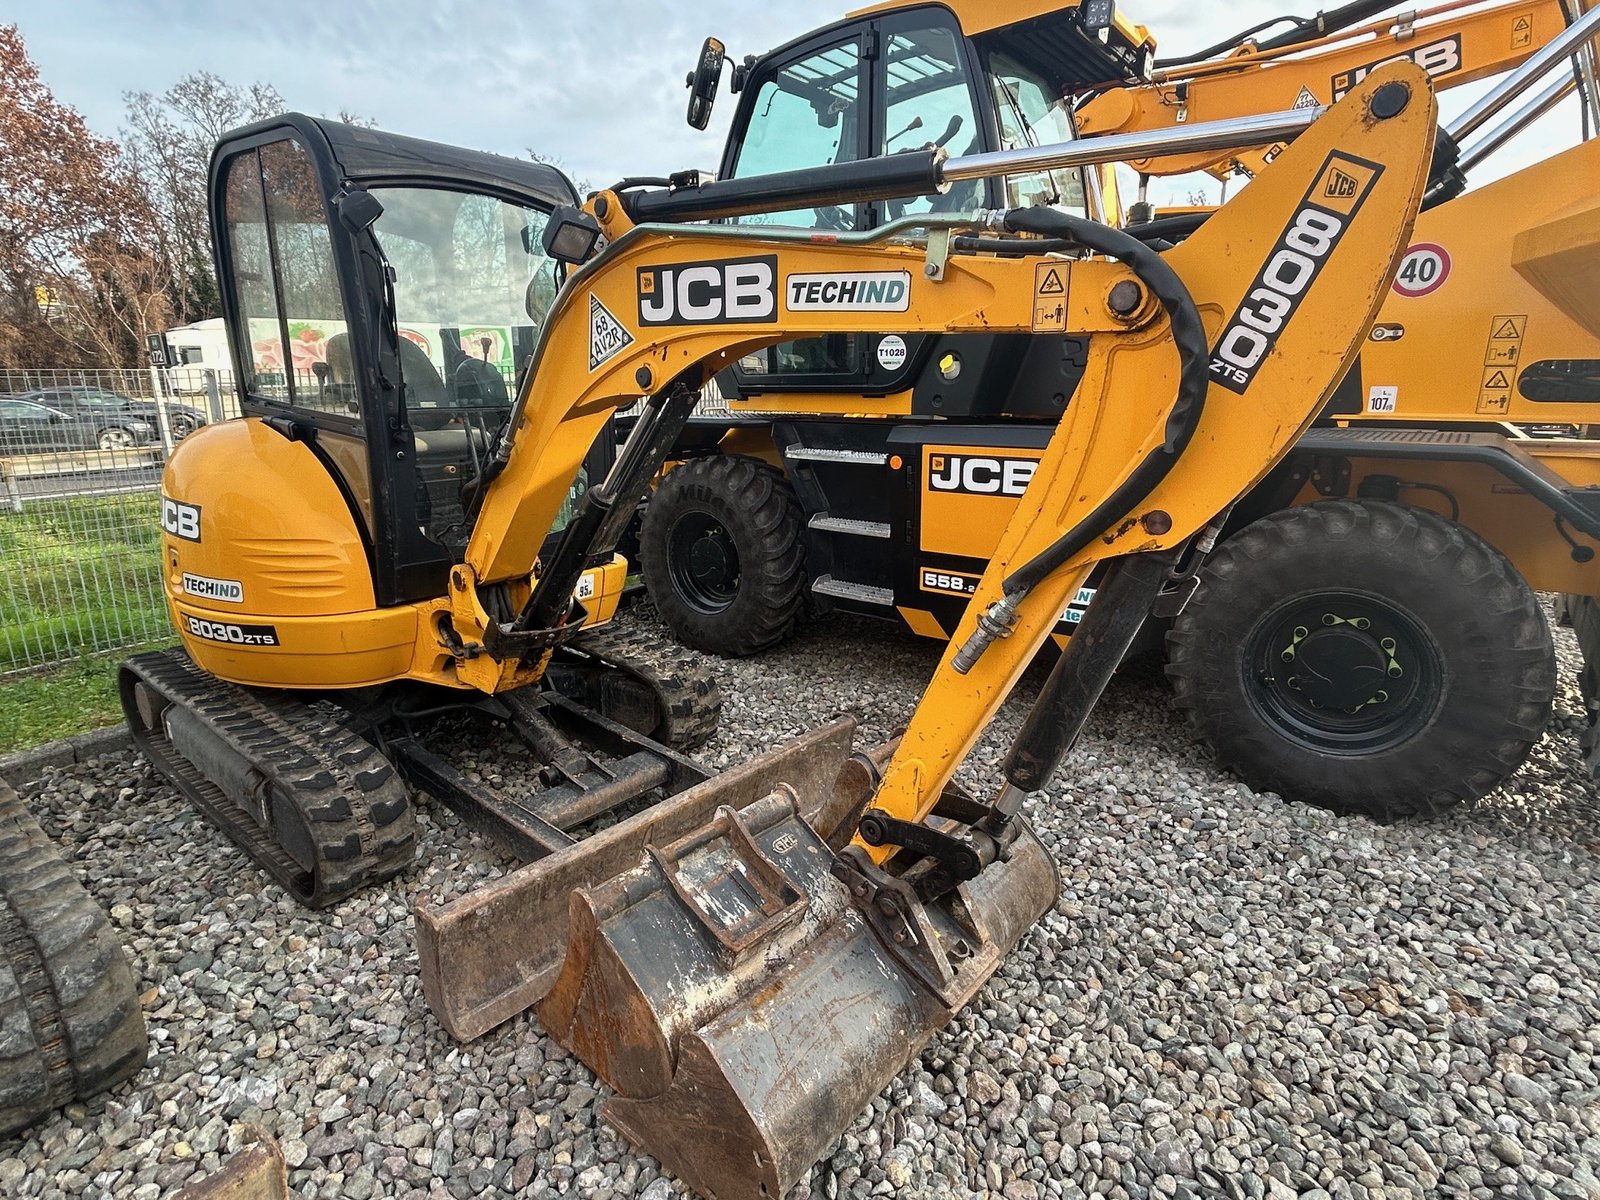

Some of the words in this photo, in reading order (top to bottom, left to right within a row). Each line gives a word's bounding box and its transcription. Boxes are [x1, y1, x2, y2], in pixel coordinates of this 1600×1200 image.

[1335, 39, 1459, 103] JB
[1327, 172, 1356, 196] JCB
[1400, 257, 1436, 283] 40
[641, 262, 774, 322] JCB
[791, 280, 905, 304] TECHIND
[1219, 208, 1342, 369] 8030
[595, 315, 609, 336] 68
[594, 326, 621, 357] AV2R
[879, 348, 905, 357] T1028
[1209, 358, 1249, 384] ZTS
[1371, 397, 1389, 410] 107
[931, 457, 1039, 494] JCB
[185, 577, 240, 598] TECHIND
[579, 585, 589, 597] 95
[188, 616, 244, 642] 8030
[244, 634, 275, 644] ZTS
